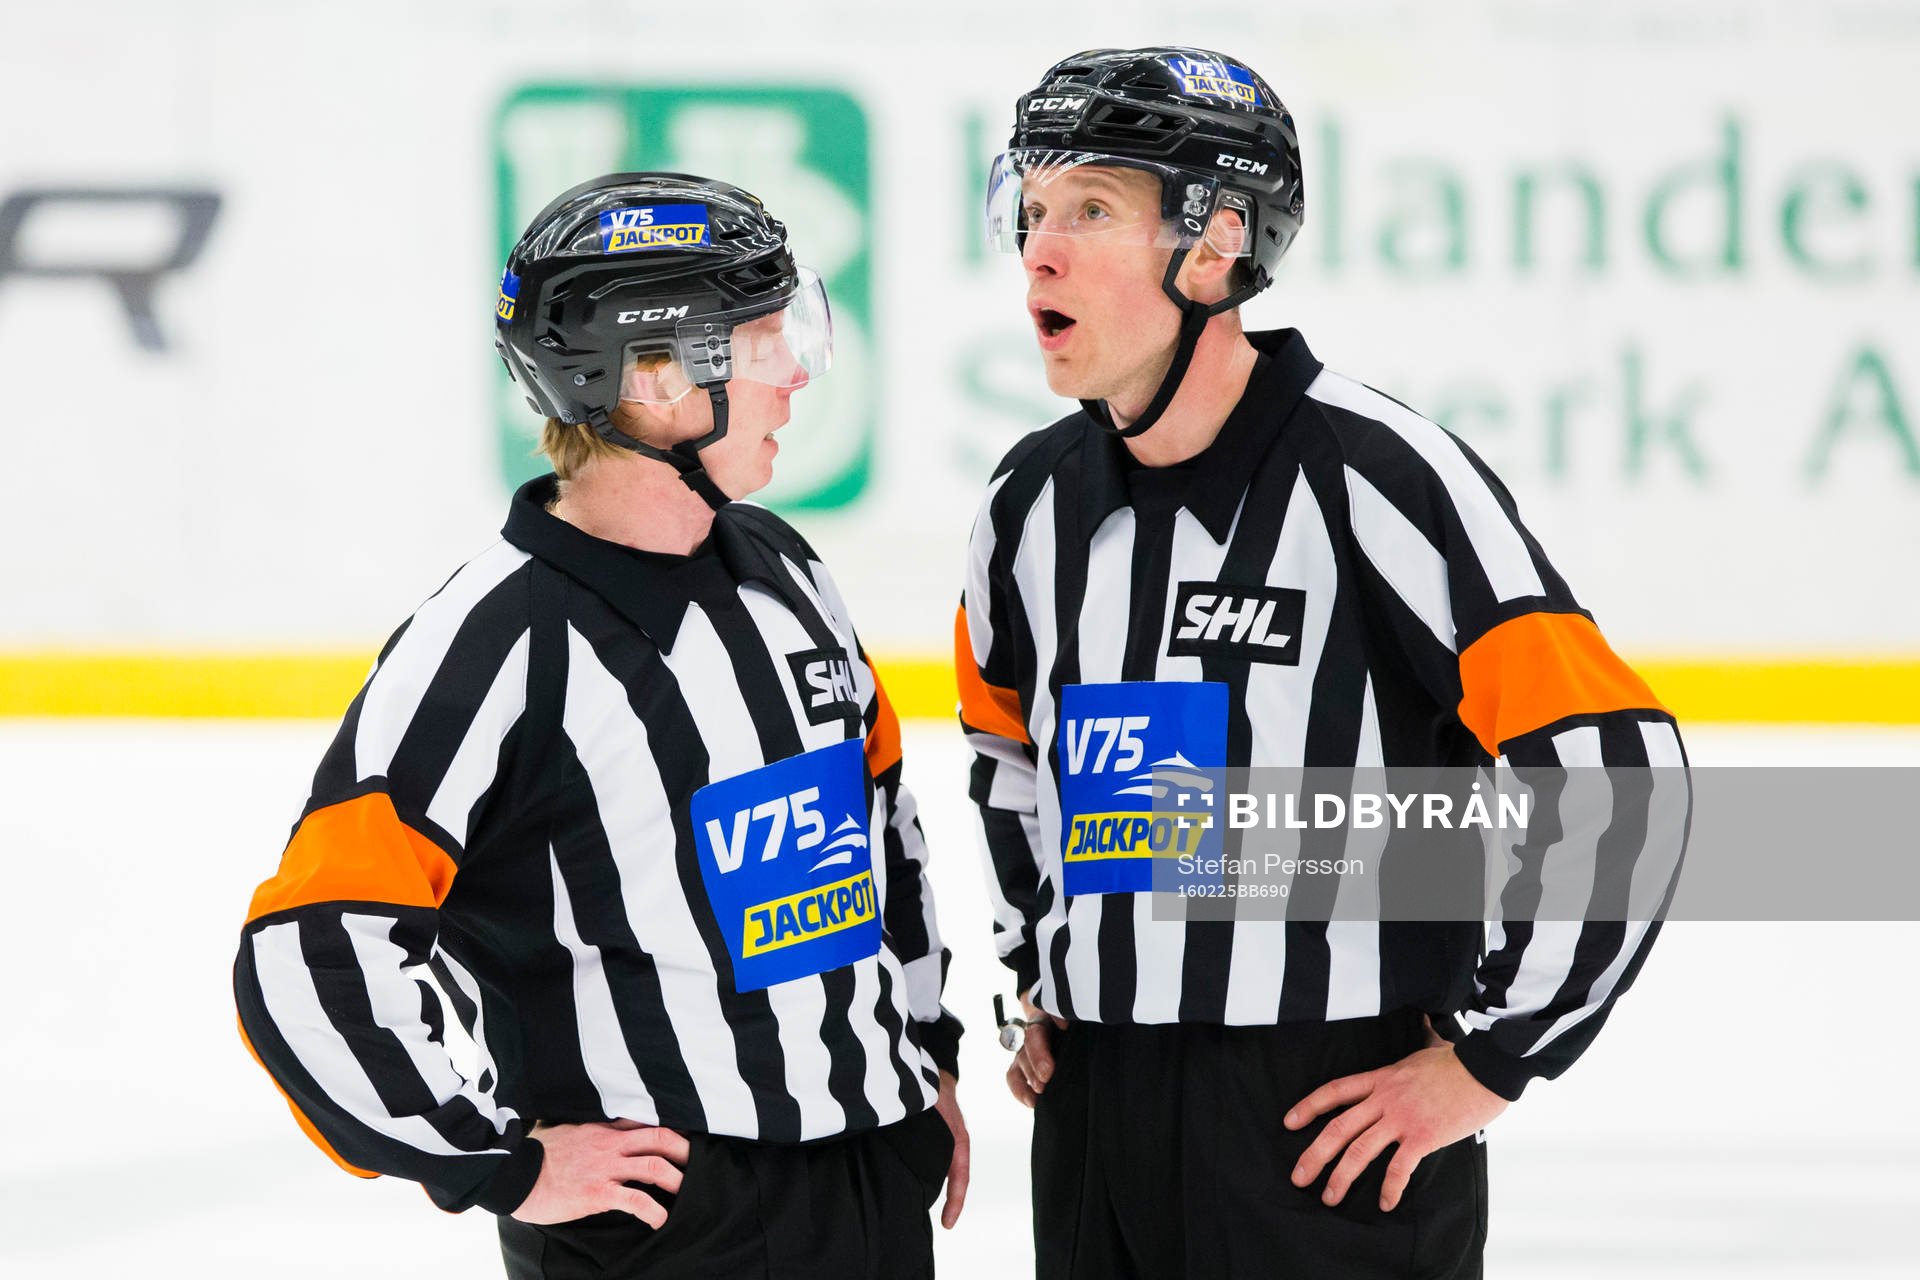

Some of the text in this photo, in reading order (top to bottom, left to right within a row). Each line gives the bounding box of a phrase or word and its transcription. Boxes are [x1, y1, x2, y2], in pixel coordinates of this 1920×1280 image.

[1178, 60, 1217, 77] V75
[1027, 98, 1087, 112] CCM
[1216, 153, 1269, 176] CCM
[610, 208, 654, 229] V75
[615, 226, 700, 248] JACKPOT
[617, 305, 690, 324] CCM
[1176, 594, 1292, 649] SHL
[1066, 716, 1151, 776] V75
[705, 785, 827, 875] V75
[1071, 816, 1200, 856] JACKPOT
[751, 878, 874, 948] JACKPOT
